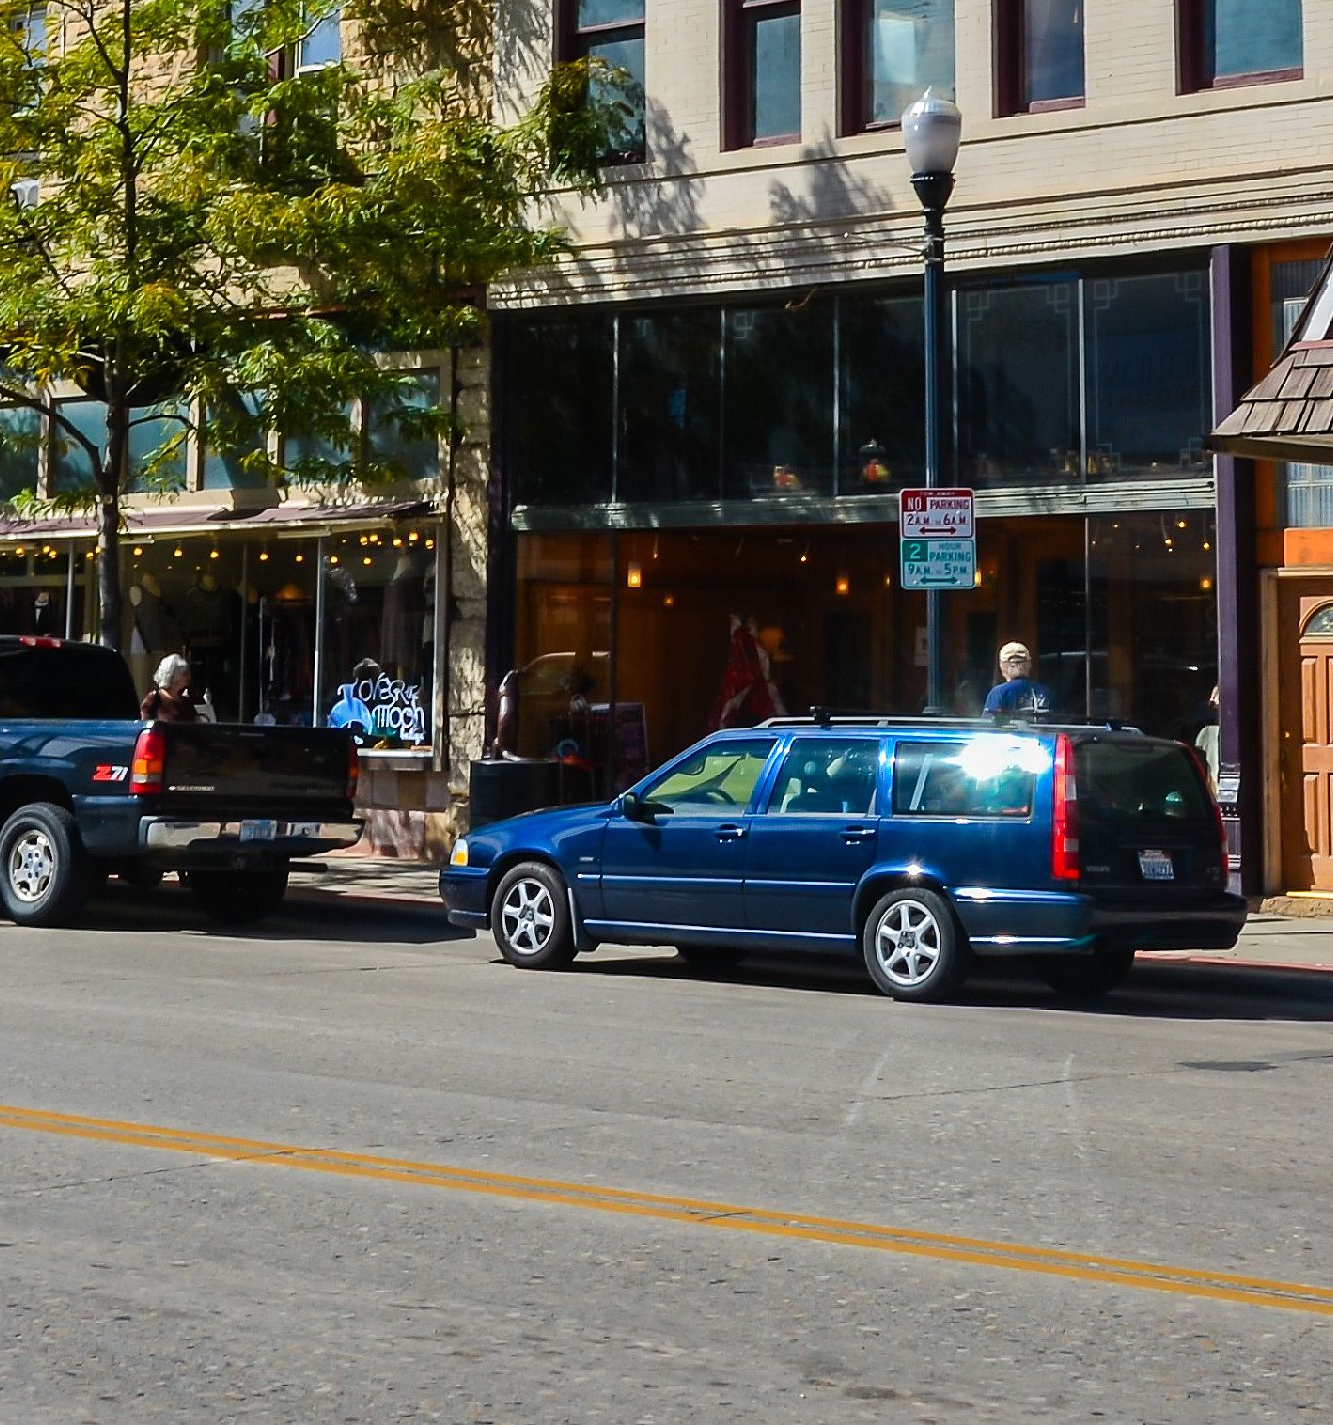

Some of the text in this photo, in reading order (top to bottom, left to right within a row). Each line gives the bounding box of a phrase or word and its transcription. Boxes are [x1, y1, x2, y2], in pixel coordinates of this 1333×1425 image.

[908, 497, 969, 511] NO PARKING
[909, 543, 971, 562] 2 PARKING
[92, 765, 129, 782] Z71
